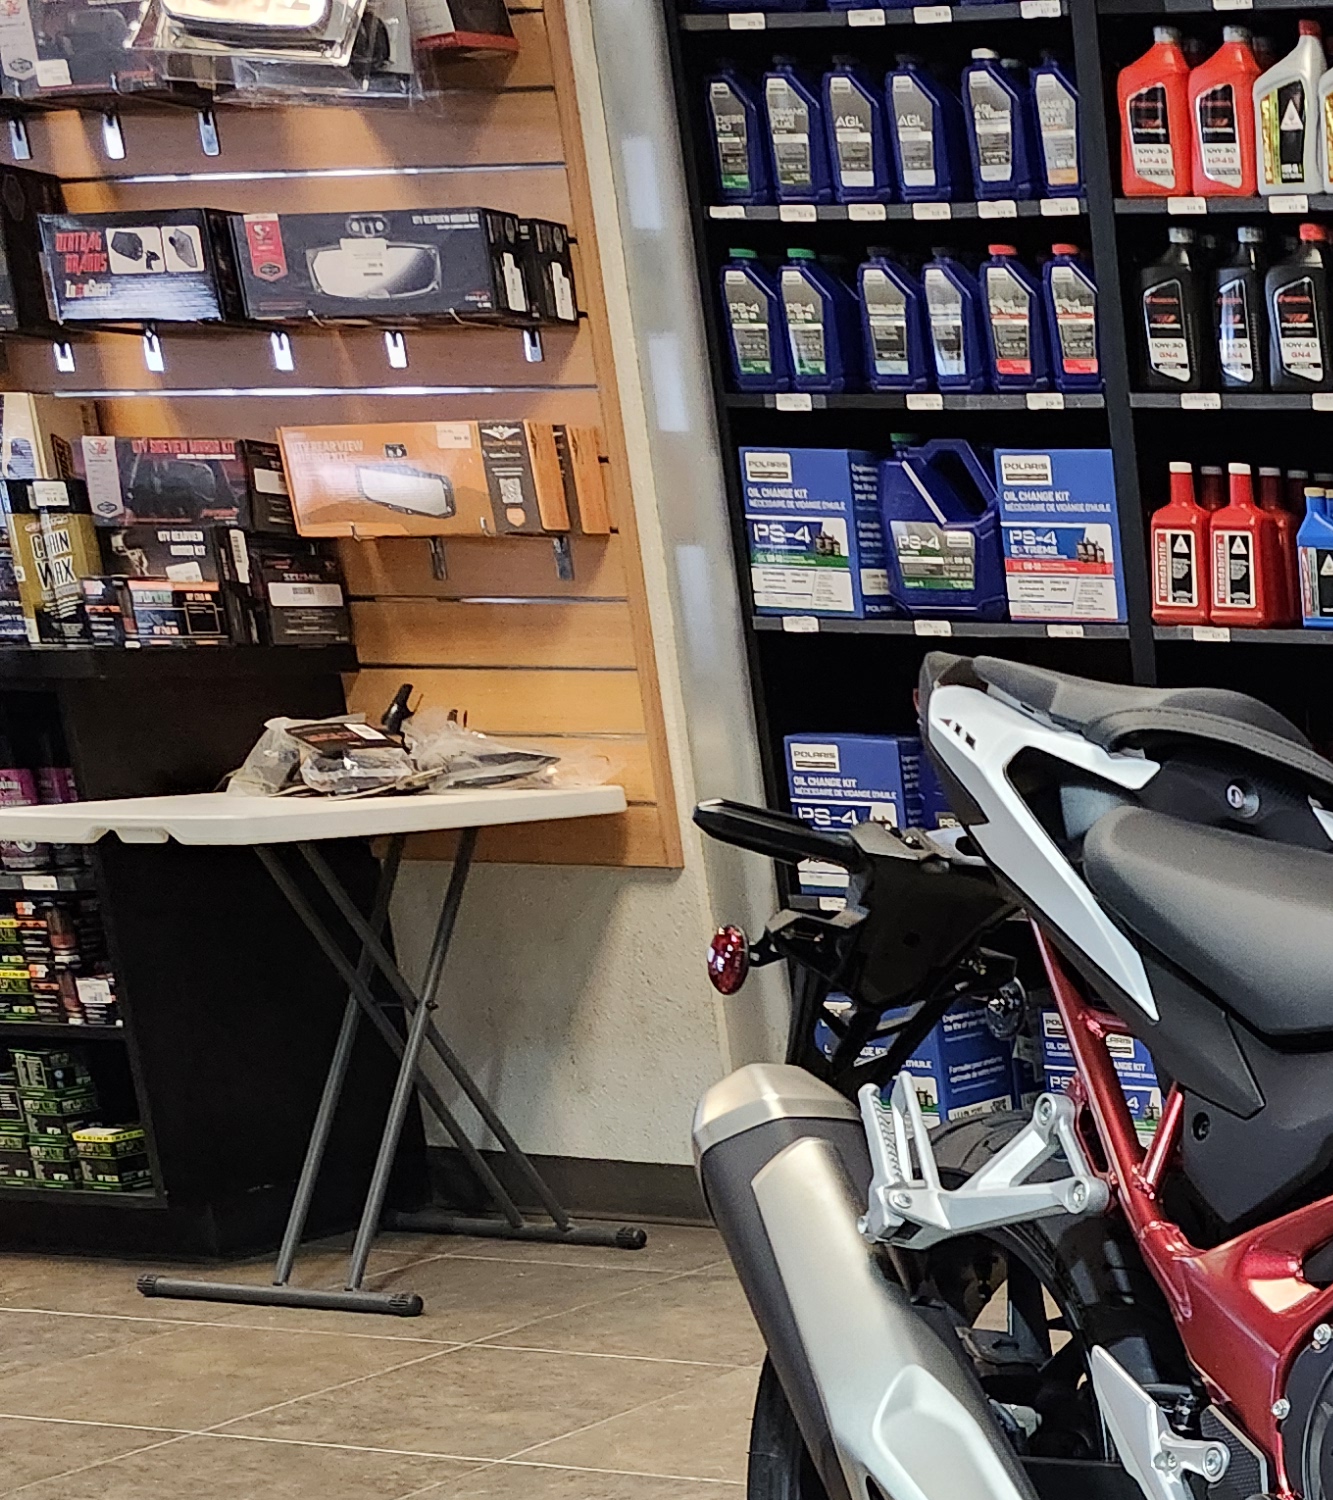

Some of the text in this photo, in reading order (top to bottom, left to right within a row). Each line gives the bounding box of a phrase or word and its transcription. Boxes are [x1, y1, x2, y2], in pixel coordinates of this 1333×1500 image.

[1019, 491, 1070, 502] CHANGE KIT
[754, 524, 811, 544] PS-4
[1009, 530, 1057, 545] PS-4
[898, 535, 939, 550] PS-4
[35, 556, 77, 590] WAX
[794, 751, 836, 759] POLARIS
[843, 778, 857, 787] KIT
[798, 807, 859, 826] PS-4
